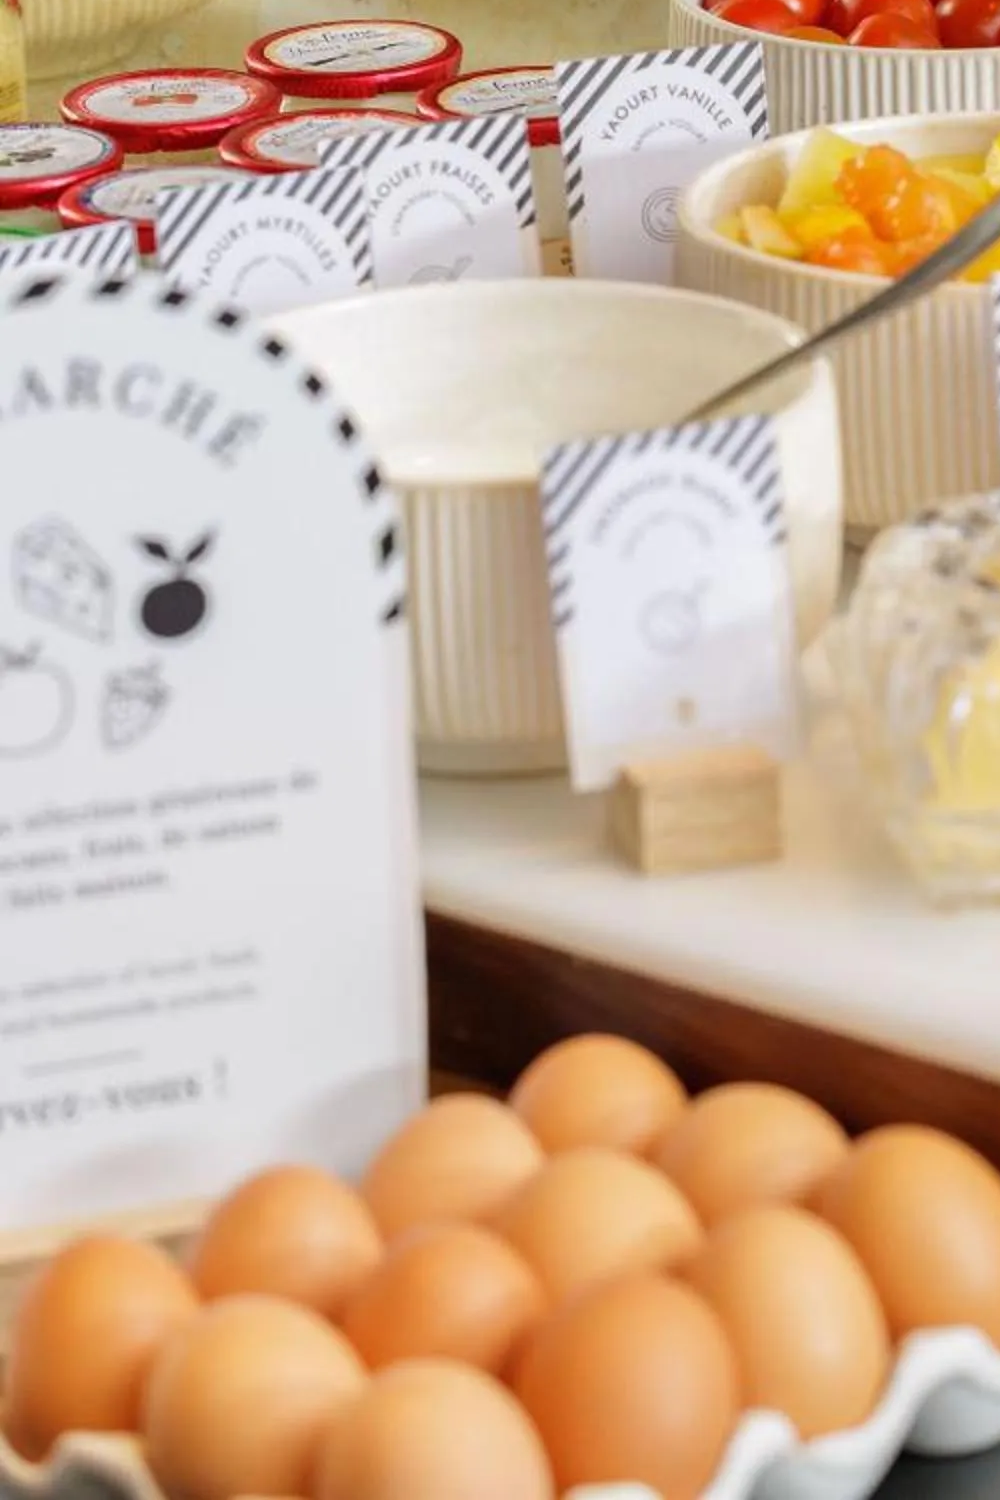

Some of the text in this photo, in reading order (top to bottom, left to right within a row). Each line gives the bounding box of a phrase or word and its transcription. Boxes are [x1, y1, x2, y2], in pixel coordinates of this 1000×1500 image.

[600, 84, 660, 143] YAOURT
[666, 82, 733, 132] VANILLE
[430, 160, 496, 206] FRAISES
[199, 221, 249, 288] YAOURT
[256, 216, 338, 273] MYRTILLES
